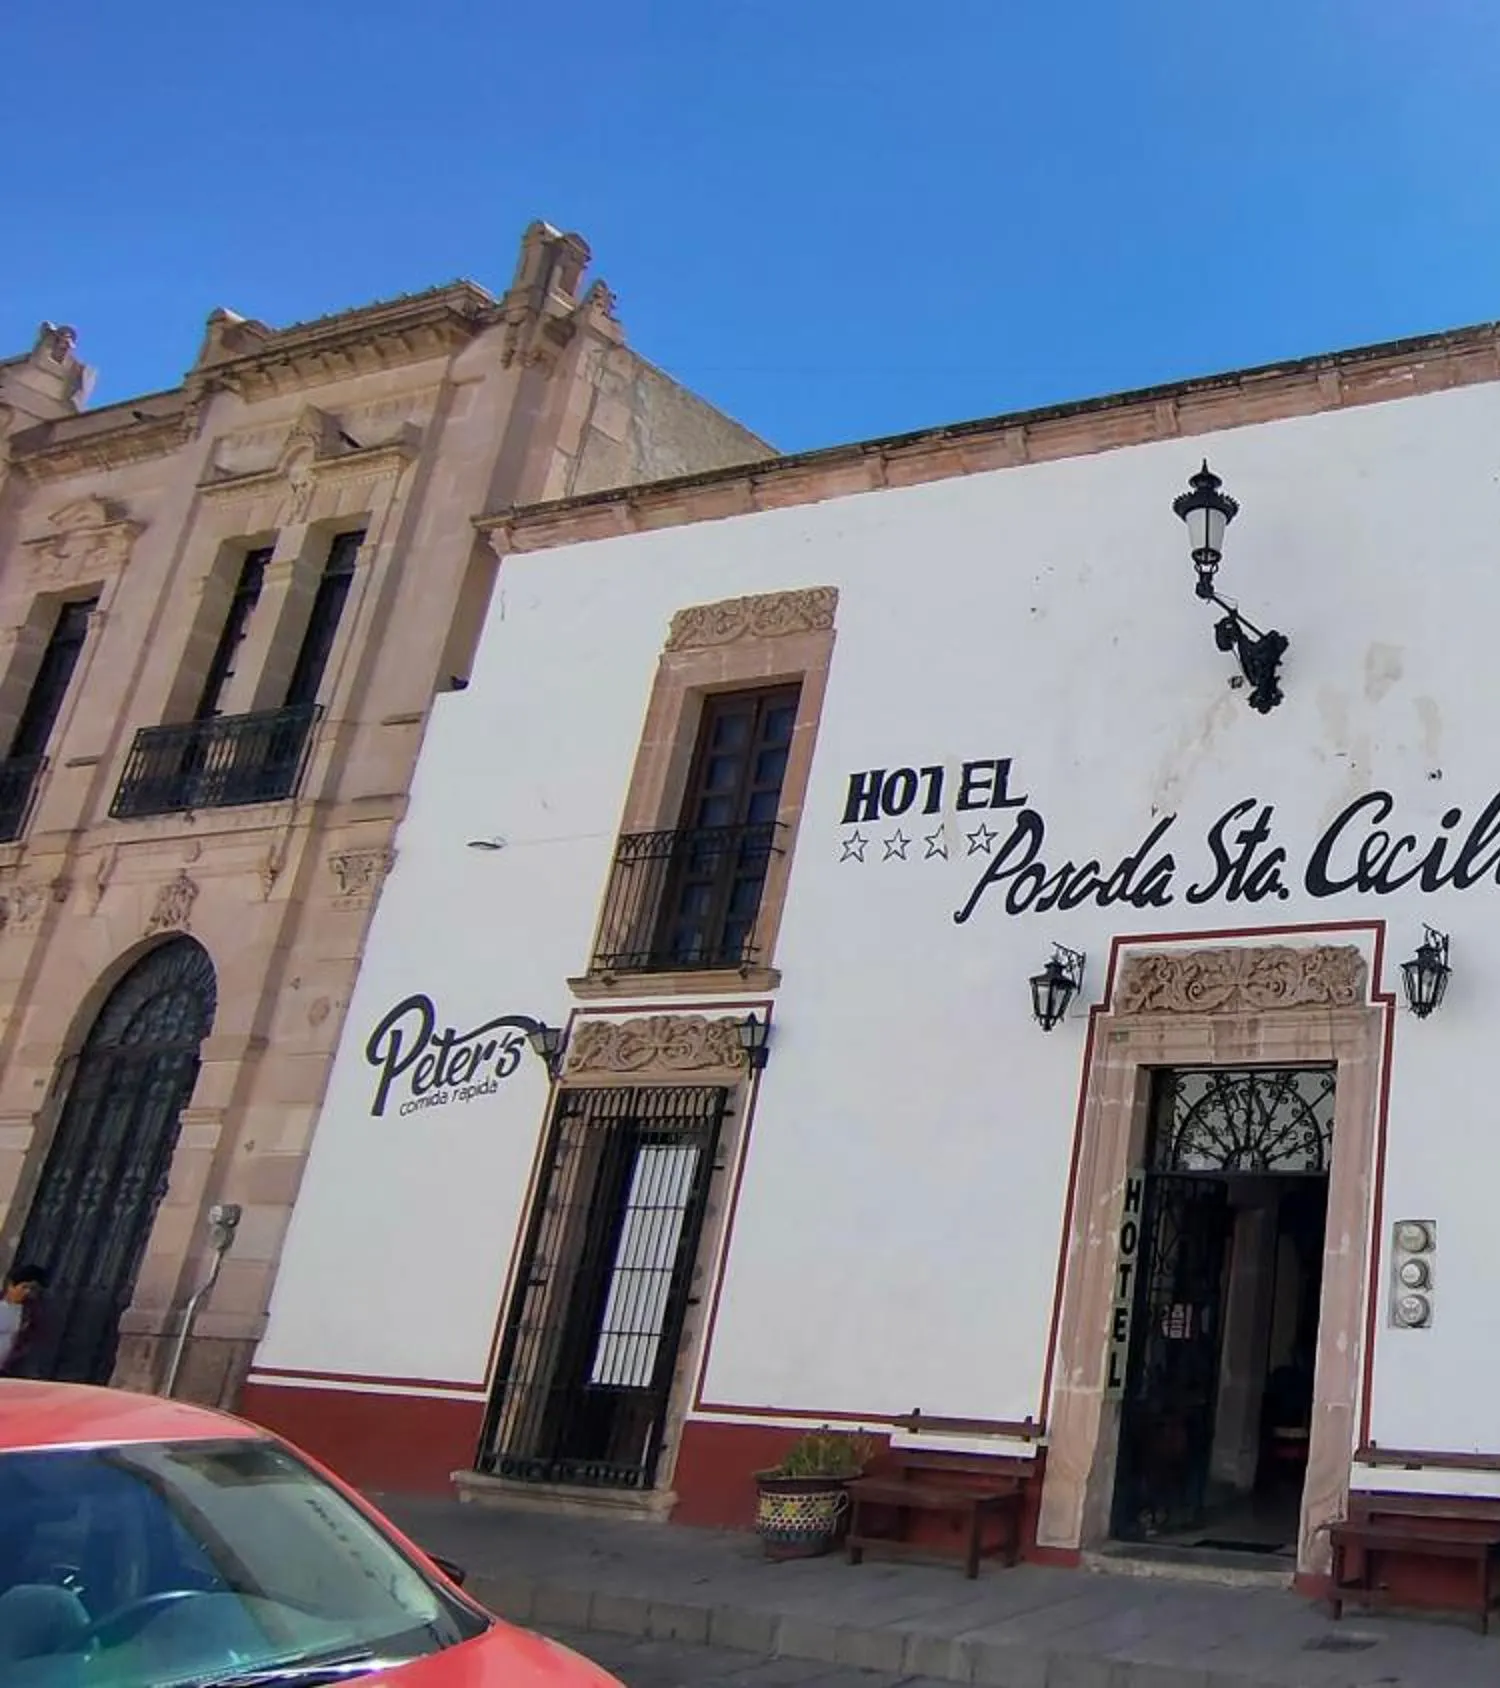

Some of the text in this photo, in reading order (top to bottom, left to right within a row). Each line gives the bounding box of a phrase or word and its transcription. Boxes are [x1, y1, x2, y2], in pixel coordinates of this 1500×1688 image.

[840, 758, 1028, 824] HOTEL
[954, 809, 1177, 924] Posada
[1186, 798, 1289, 904] Sta.
[366, 993, 540, 1116] Peter's
[400, 1090, 448, 1116] comida
[1108, 1178, 1142, 1388] HOTEL
